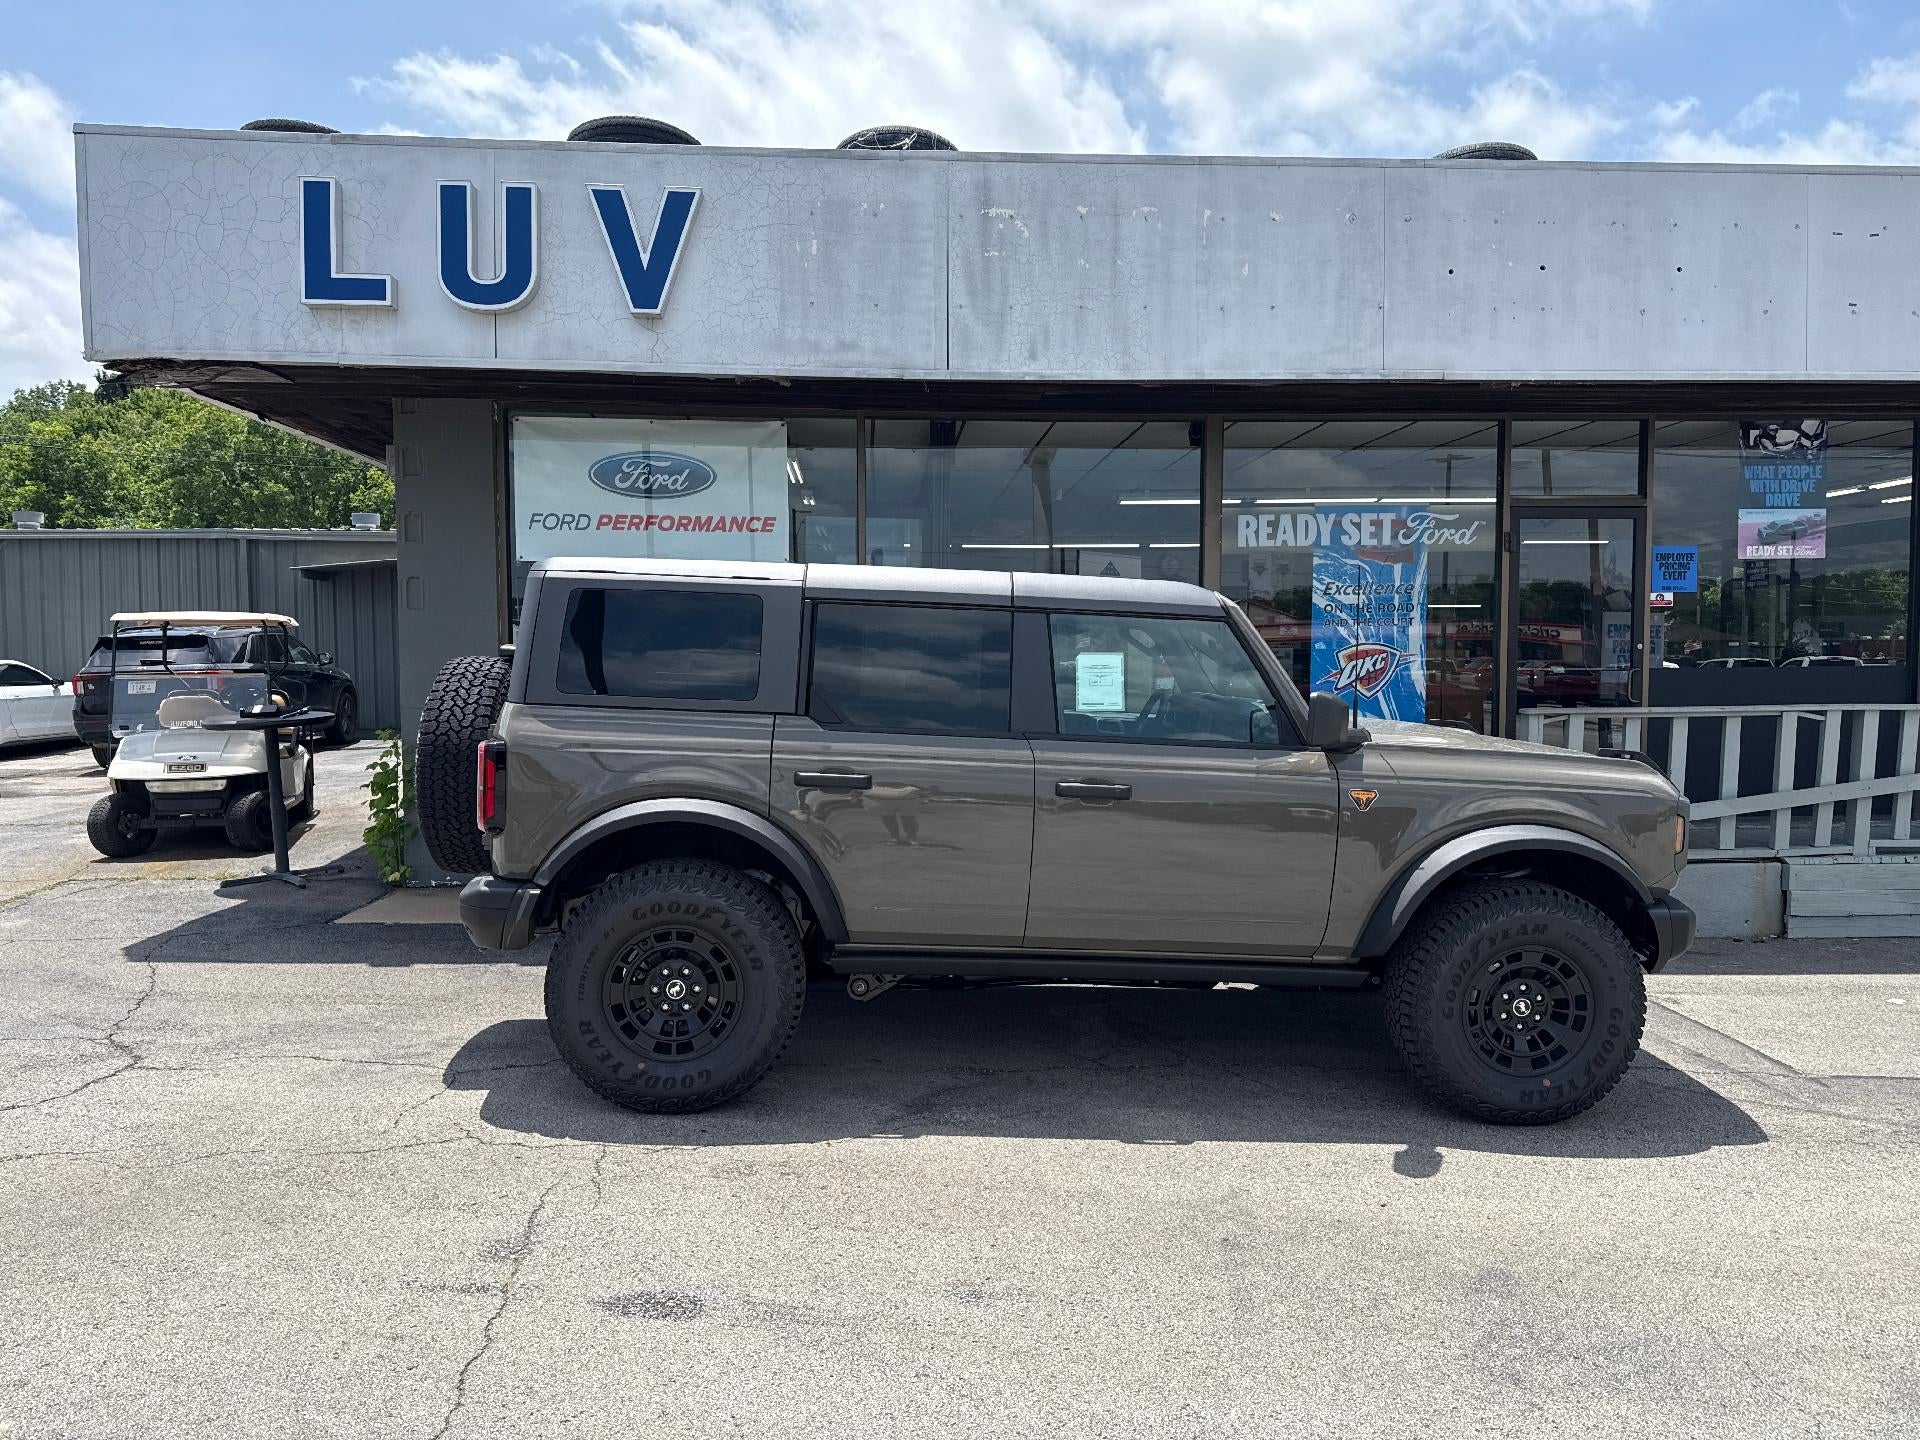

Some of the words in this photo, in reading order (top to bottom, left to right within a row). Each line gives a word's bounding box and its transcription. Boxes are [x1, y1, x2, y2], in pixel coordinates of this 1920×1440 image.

[298, 175, 703, 319] LUV
[614, 459, 690, 492] Ford
[1743, 465, 1776, 479] WHAT
[1777, 464, 1823, 479] PEOPLE
[1749, 479, 1781, 493] WITH
[1765, 493, 1801, 507] DRIVE
[528, 512, 591, 532] FORD
[596, 513, 777, 533] PERFORMANCE
[1237, 512, 1337, 548] READY
[1340, 511, 1397, 547] SET
[1397, 510, 1486, 546] Ford
[1655, 552, 1696, 562] EMPLOYEE
[1746, 545, 1777, 557] READY
[1777, 545, 1794, 556] SET
[1793, 545, 1818, 557] Ford
[1662, 571, 1688, 581] EVENT
[1322, 580, 1415, 598] Excellence
[1323, 602, 1344, 615] ON
[1347, 602, 1374, 615] THE
[1377, 601, 1416, 614] ROAD
[1323, 617, 1347, 628] AND
[1350, 617, 1374, 628] THE
[1377, 616, 1416, 627] COURT
[1334, 650, 1389, 689] OKC
